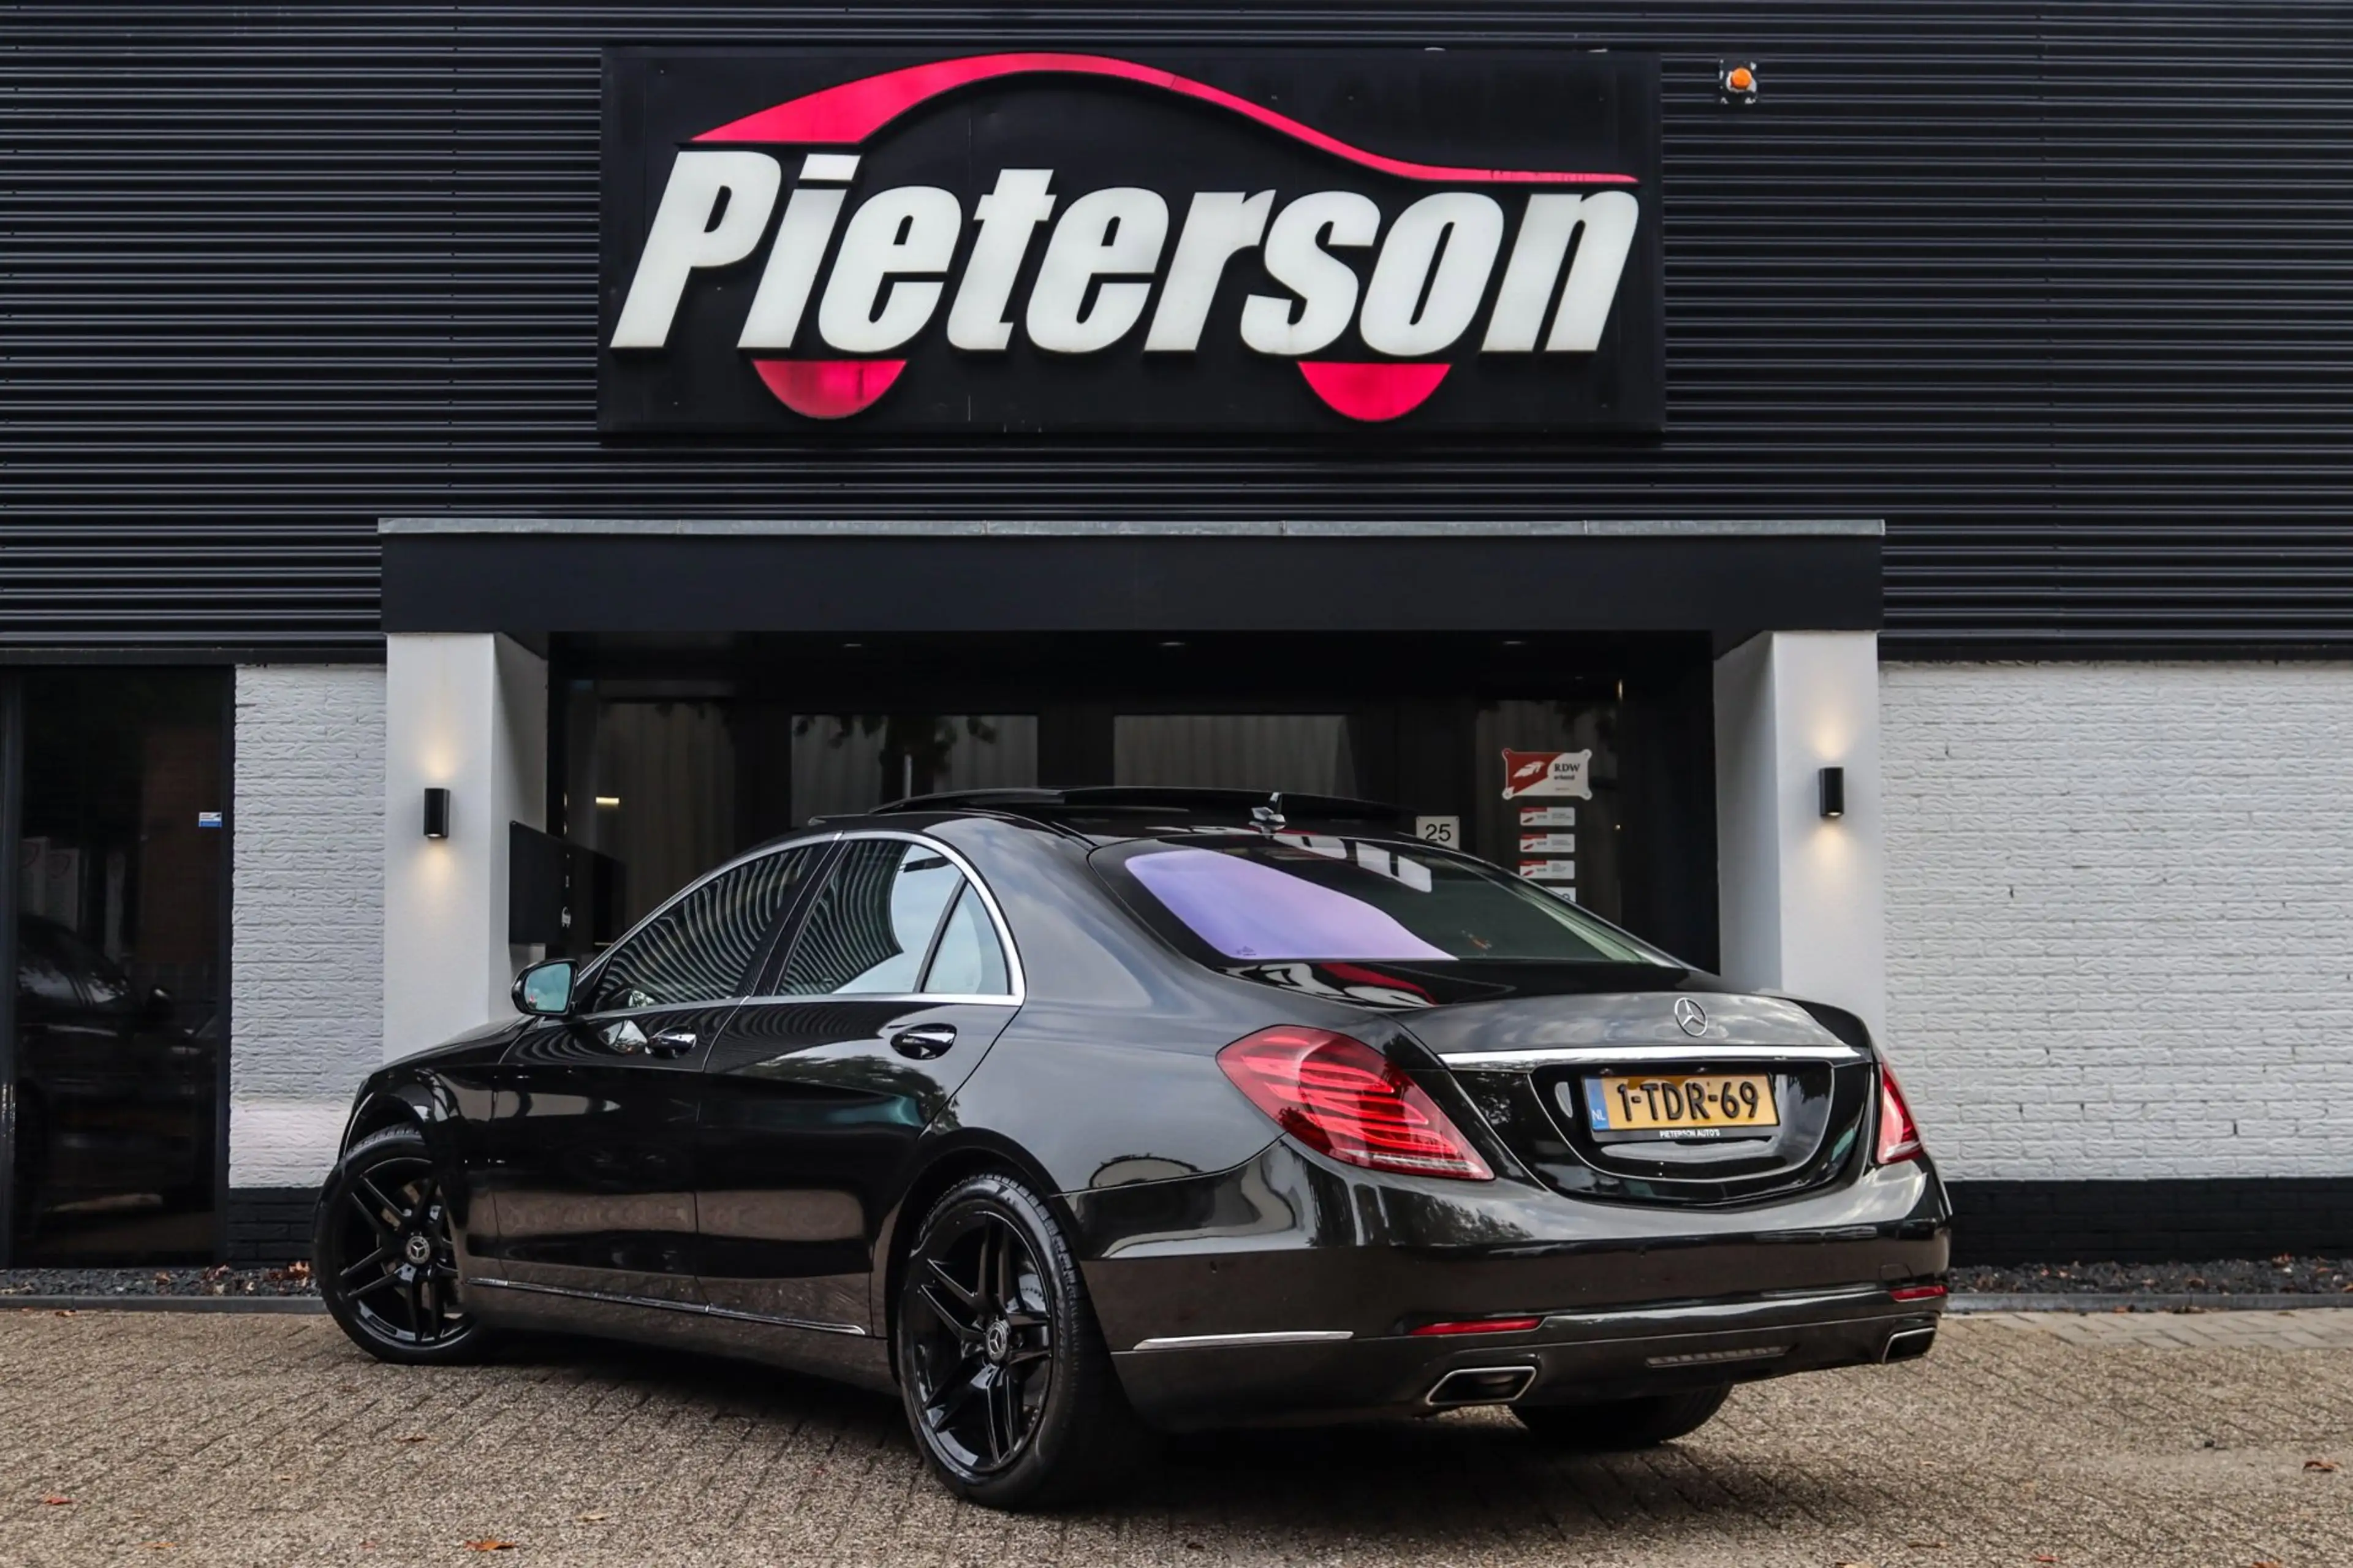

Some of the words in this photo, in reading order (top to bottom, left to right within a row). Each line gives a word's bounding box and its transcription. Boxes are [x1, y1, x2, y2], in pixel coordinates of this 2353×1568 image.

[610, 151, 1639, 357] Pieterson
[1554, 763, 1580, 772] RDW
[1425, 824, 1451, 842] 25
[1617, 1081, 1759, 1122] 1-TDR-69
[1591, 1109, 1606, 1122] NL
